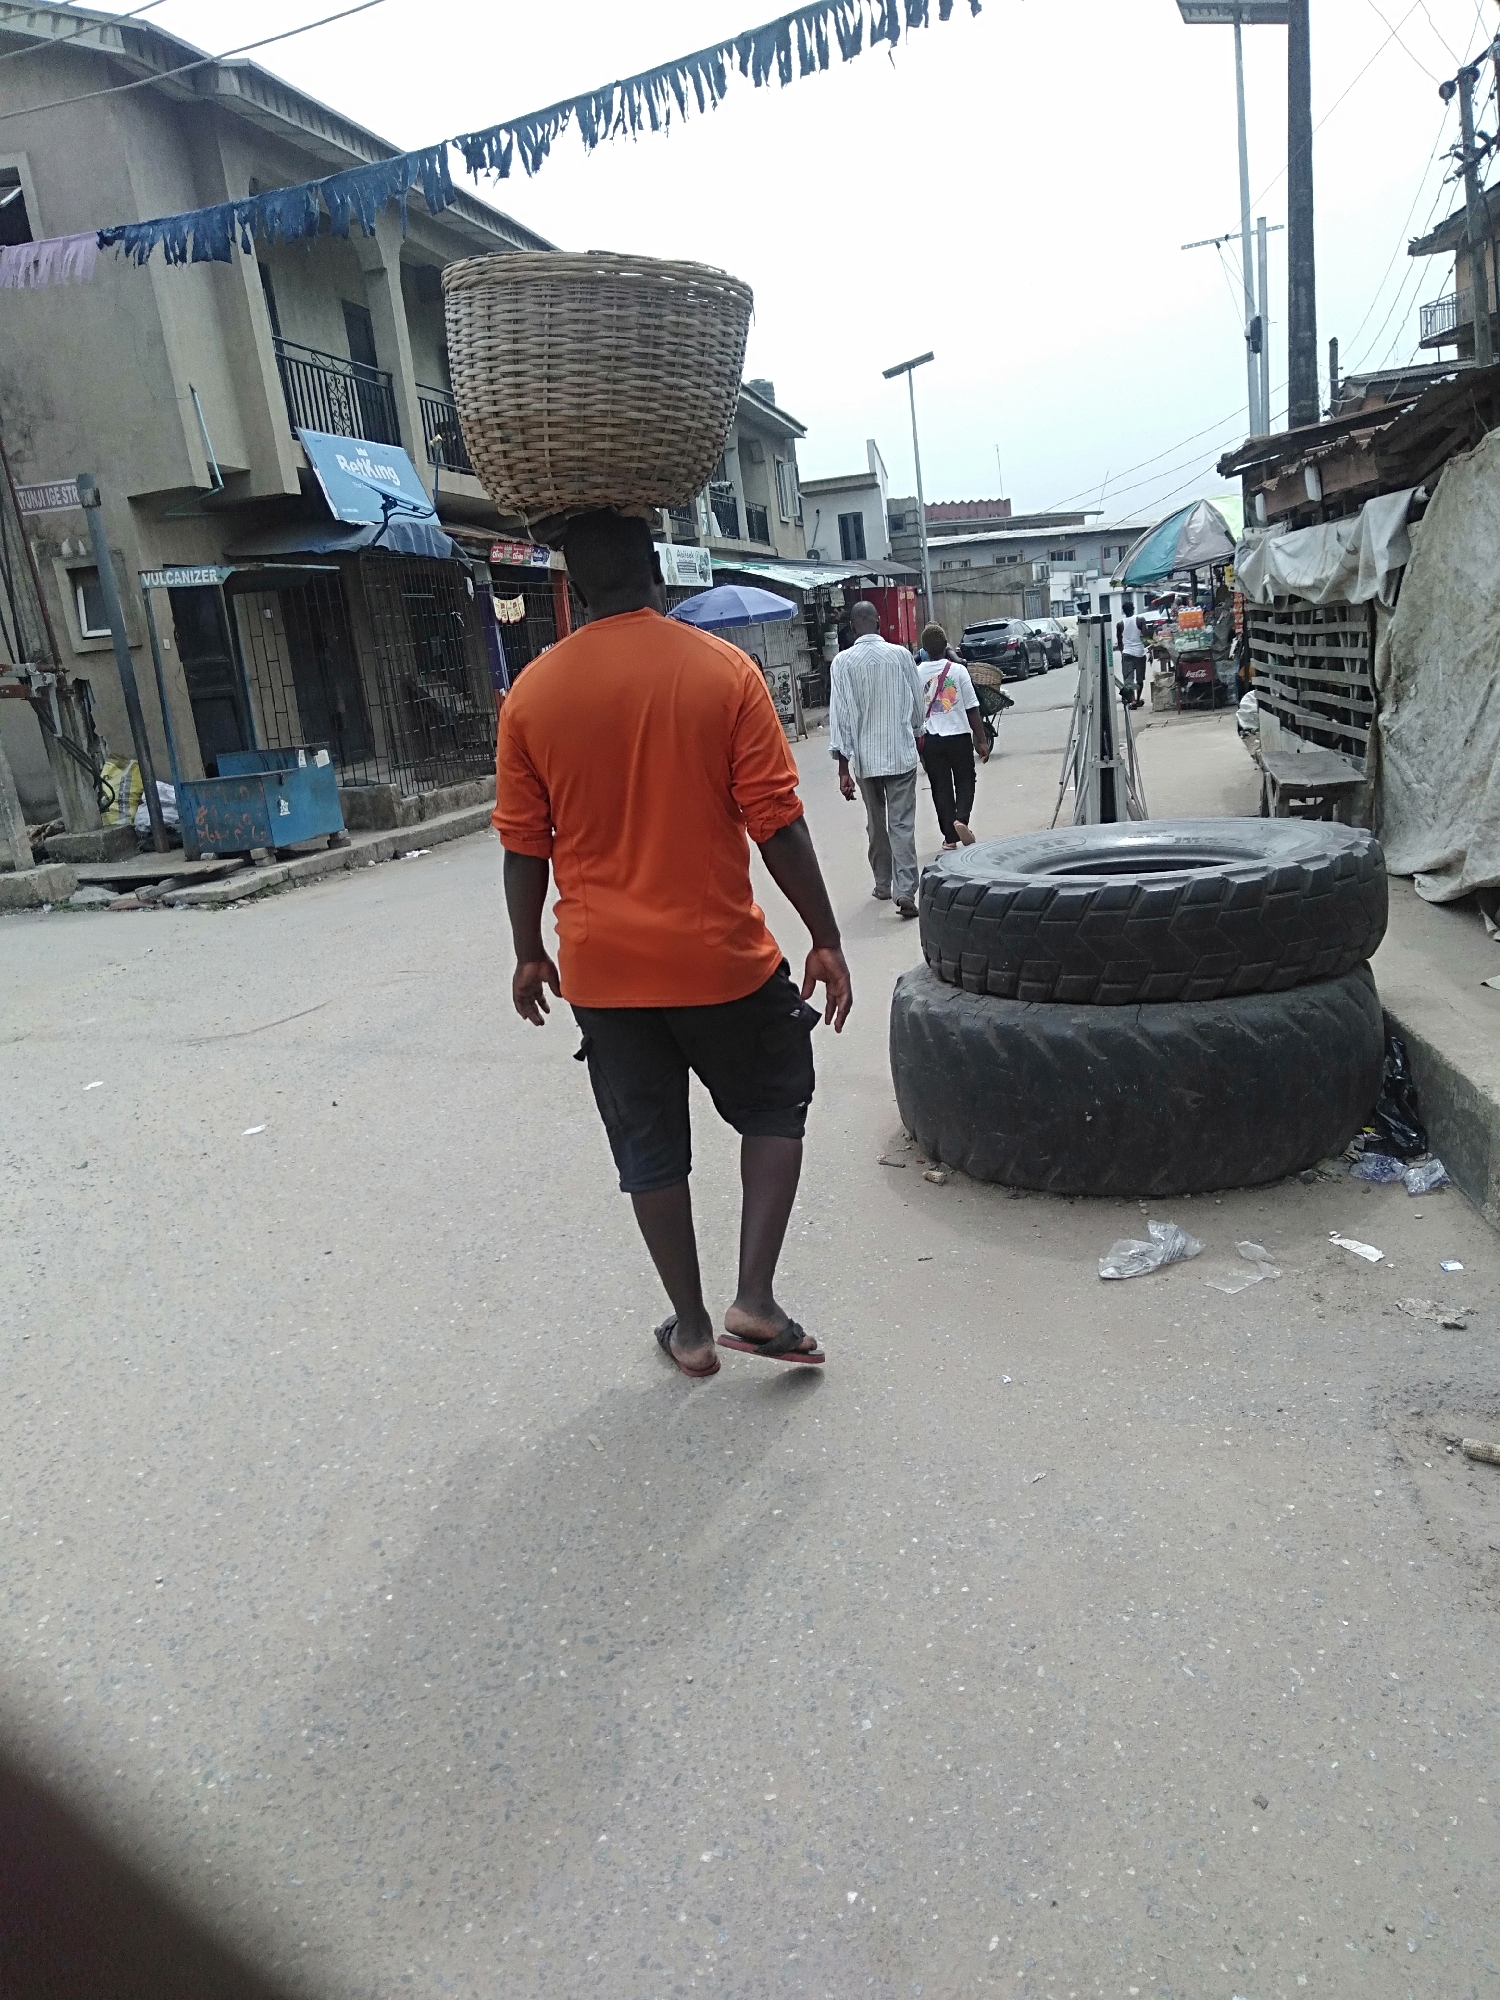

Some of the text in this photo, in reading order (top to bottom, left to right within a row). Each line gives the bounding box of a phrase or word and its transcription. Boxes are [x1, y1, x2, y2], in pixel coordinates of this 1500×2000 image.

[335, 454, 400, 487] BetKing
[45, 486, 62, 506] IGE
[141, 569, 218, 586] VULCANIZER
